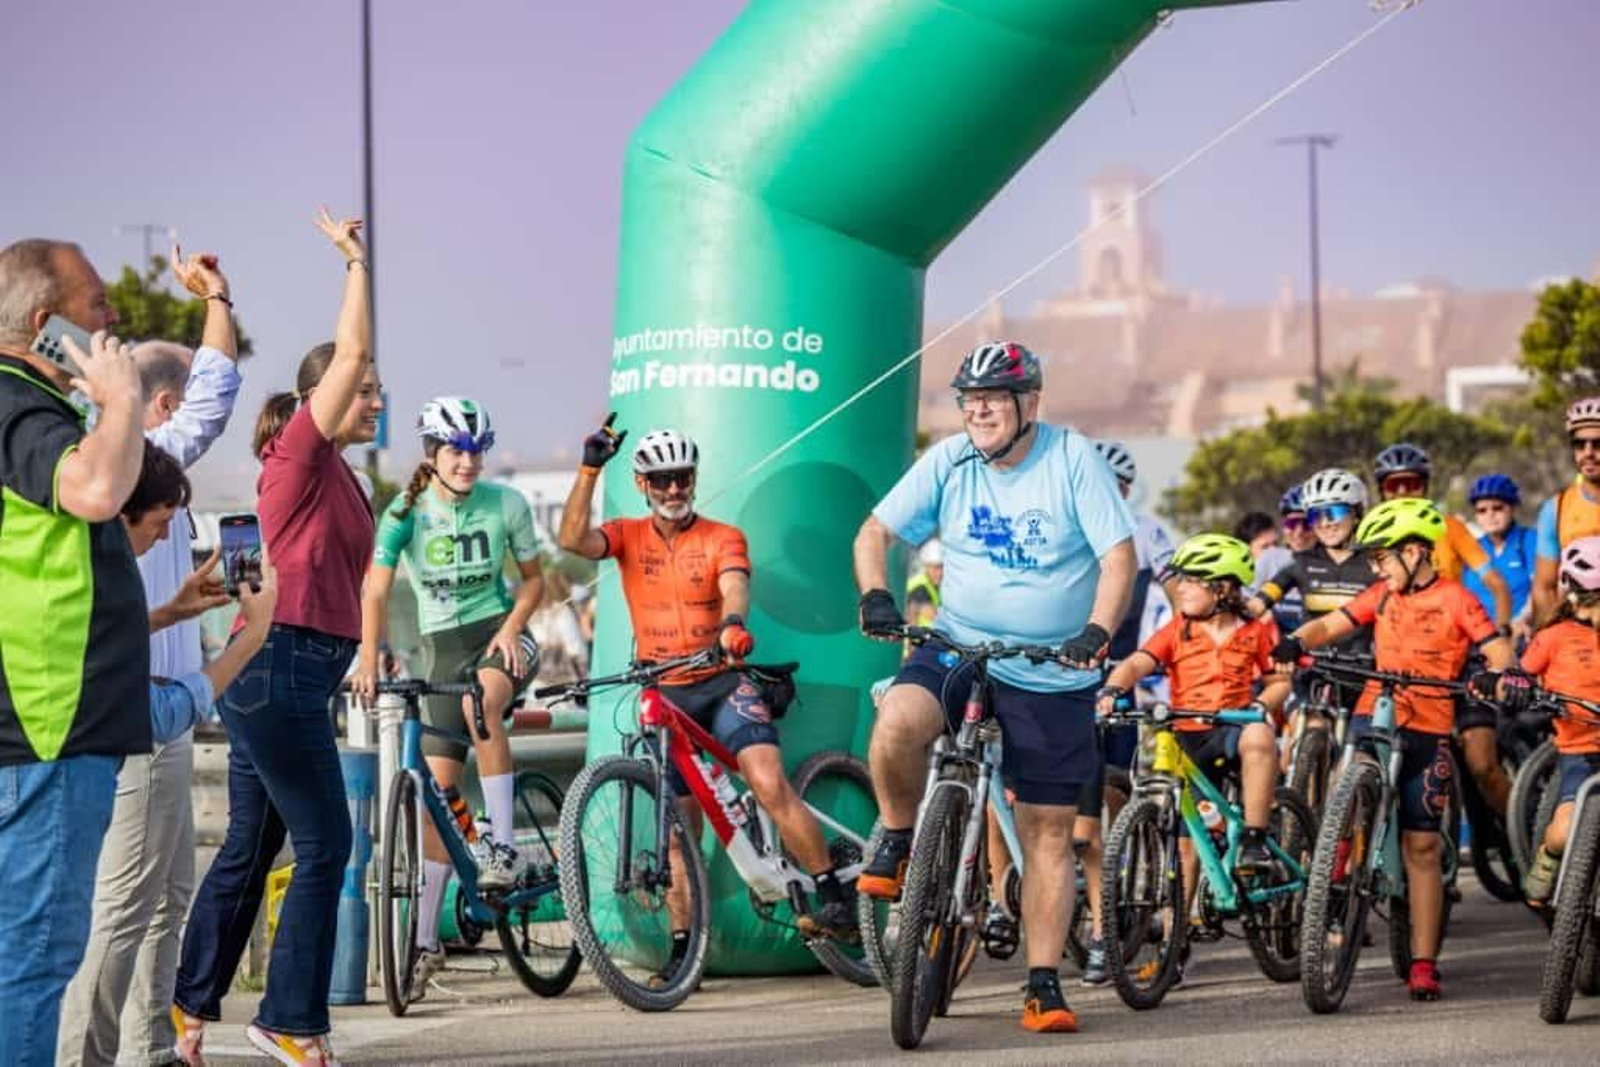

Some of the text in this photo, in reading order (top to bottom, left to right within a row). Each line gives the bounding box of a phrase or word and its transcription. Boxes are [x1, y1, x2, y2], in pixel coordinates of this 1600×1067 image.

[612, 324, 823, 364] yuntamiento de
[644, 359, 820, 392] Fernando
